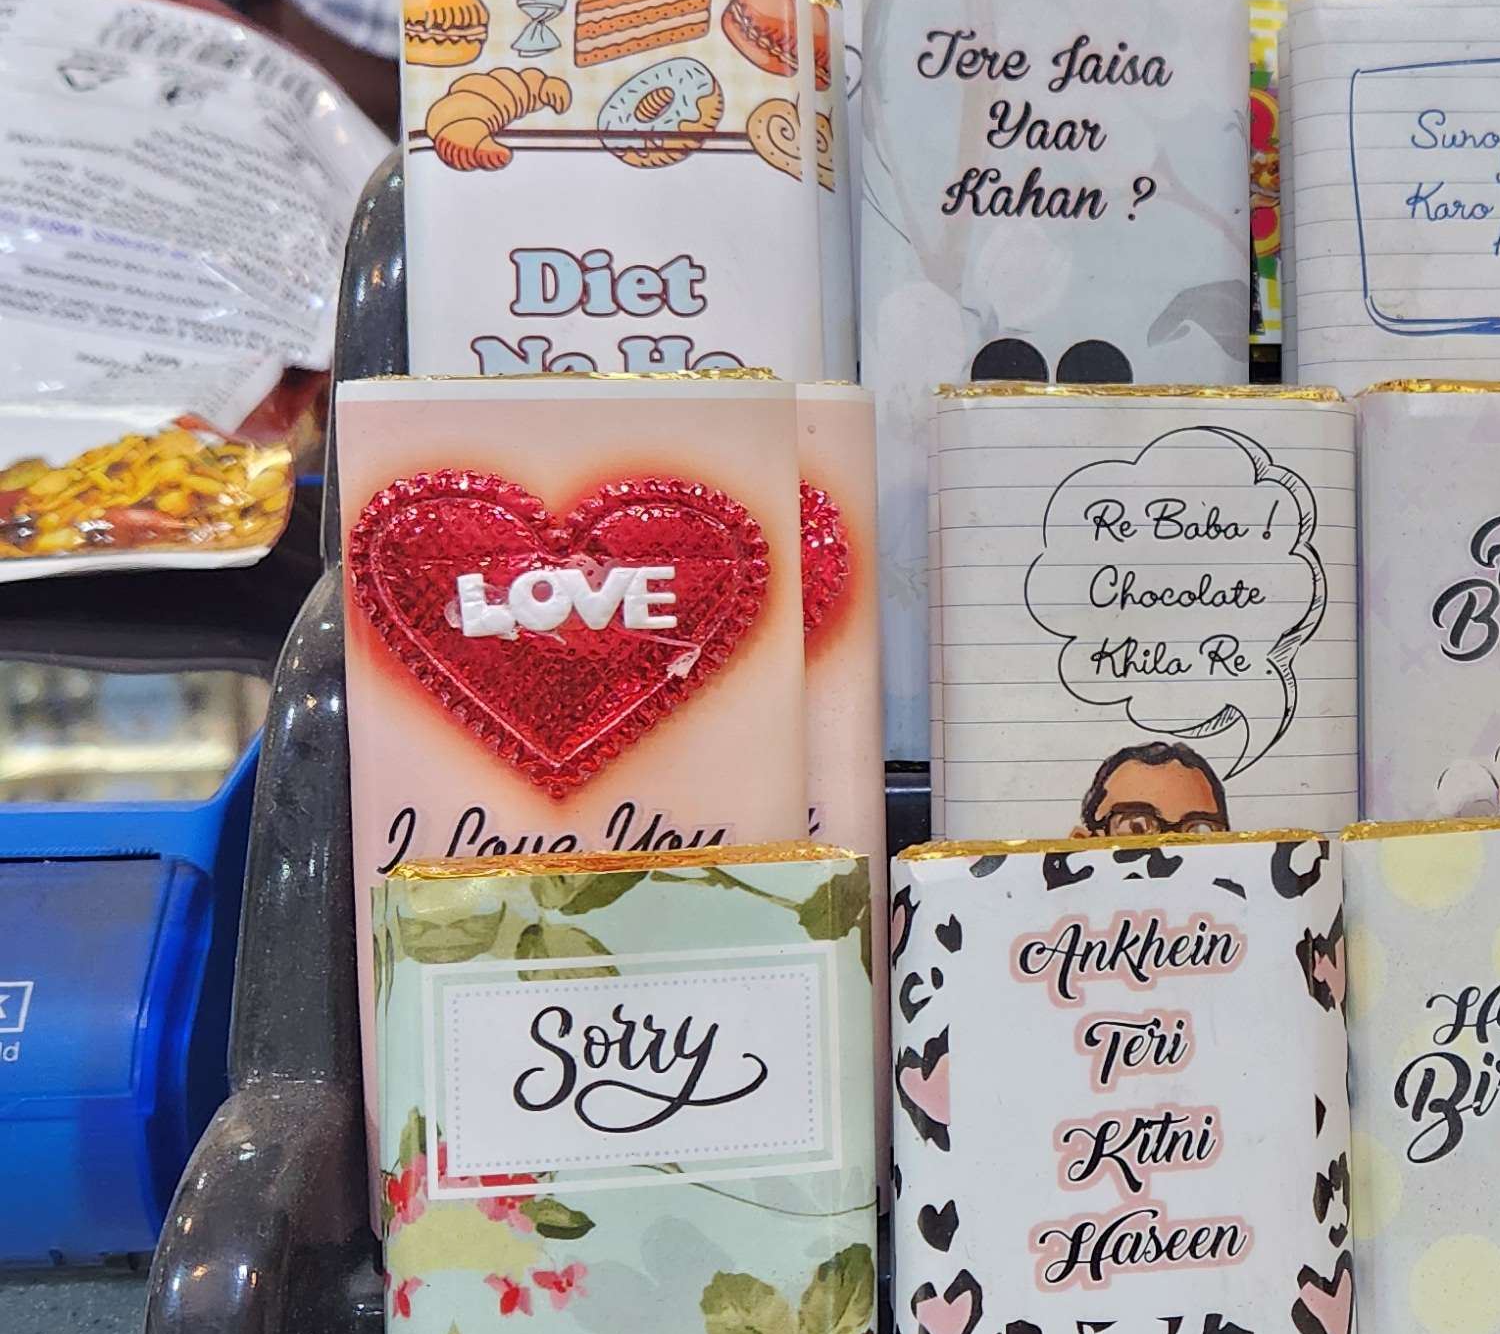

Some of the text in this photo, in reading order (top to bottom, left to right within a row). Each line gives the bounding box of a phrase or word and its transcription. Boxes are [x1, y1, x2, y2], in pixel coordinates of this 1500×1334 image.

[916, 29, 1175, 94] Tere Jaisa
[985, 99, 1108, 152] Yaar
[940, 166, 1109, 220] Kahan
[1405, 180, 1495, 222] Karo
[508, 247, 709, 318] Diet
[1083, 497, 1139, 544] Re
[1144, 496, 1250, 541] Baba
[455, 564, 679, 640] LOVE
[1088, 563, 1267, 612] Chocolate
[1089, 635, 1193, 679] Khila
[1198, 633, 1252, 677] Re
[378, 806, 417, 874] I
[1018, 916, 1242, 1001] Ankhein
[512, 1002, 769, 1135] Sorry
[1083, 1016, 1189, 1086] Teri
[1061, 1111, 1218, 1195] Kitni
[1037, 1208, 1249, 1285] Haseen
